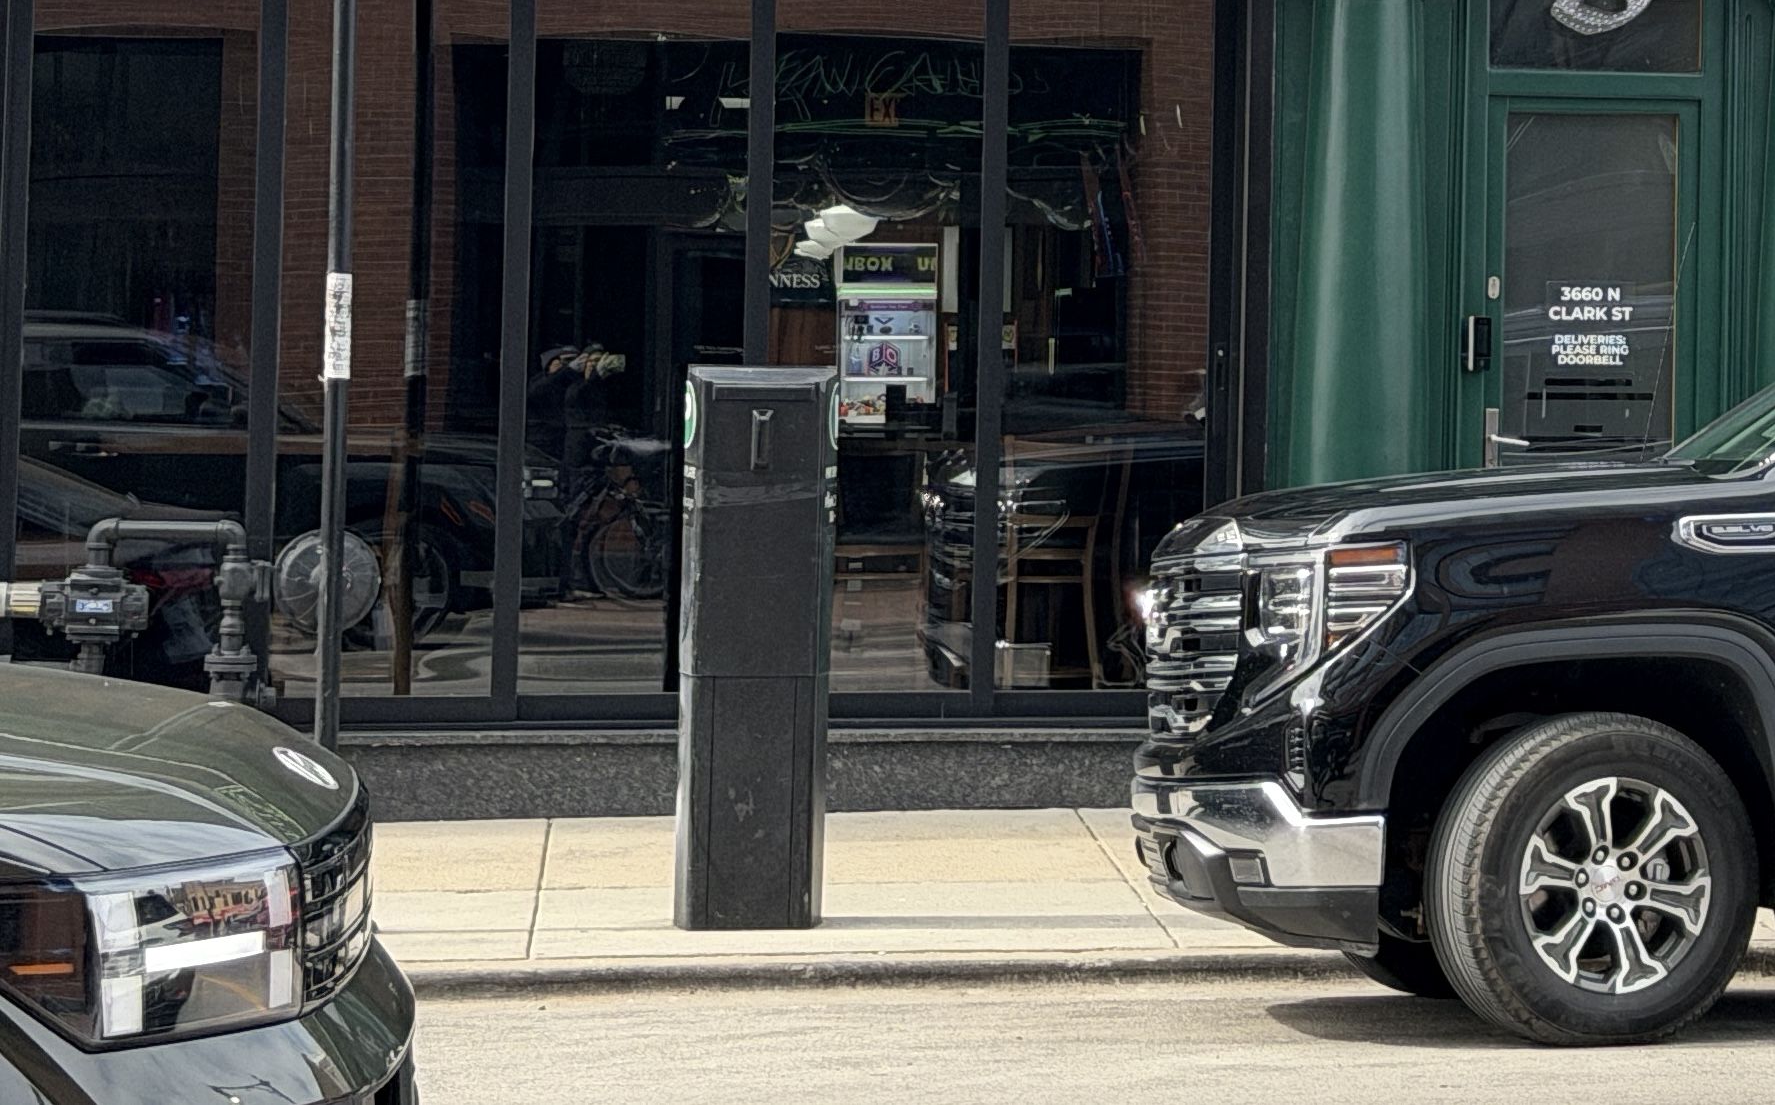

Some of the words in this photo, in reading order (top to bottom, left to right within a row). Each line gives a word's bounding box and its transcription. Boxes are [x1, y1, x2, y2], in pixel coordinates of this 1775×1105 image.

[769, 273, 821, 288] NNESS
[1561, 286, 1603, 301] 3660
[1607, 286, 1621, 301] N
[1548, 306, 1608, 321] CLARK
[1611, 306, 1634, 321] ST
[1554, 334, 1627, 345] DELIVERIES:
[1551, 344, 1597, 355] PLEASE
[1600, 345, 1630, 356] RING
[1557, 354, 1623, 366] DOORBELL
